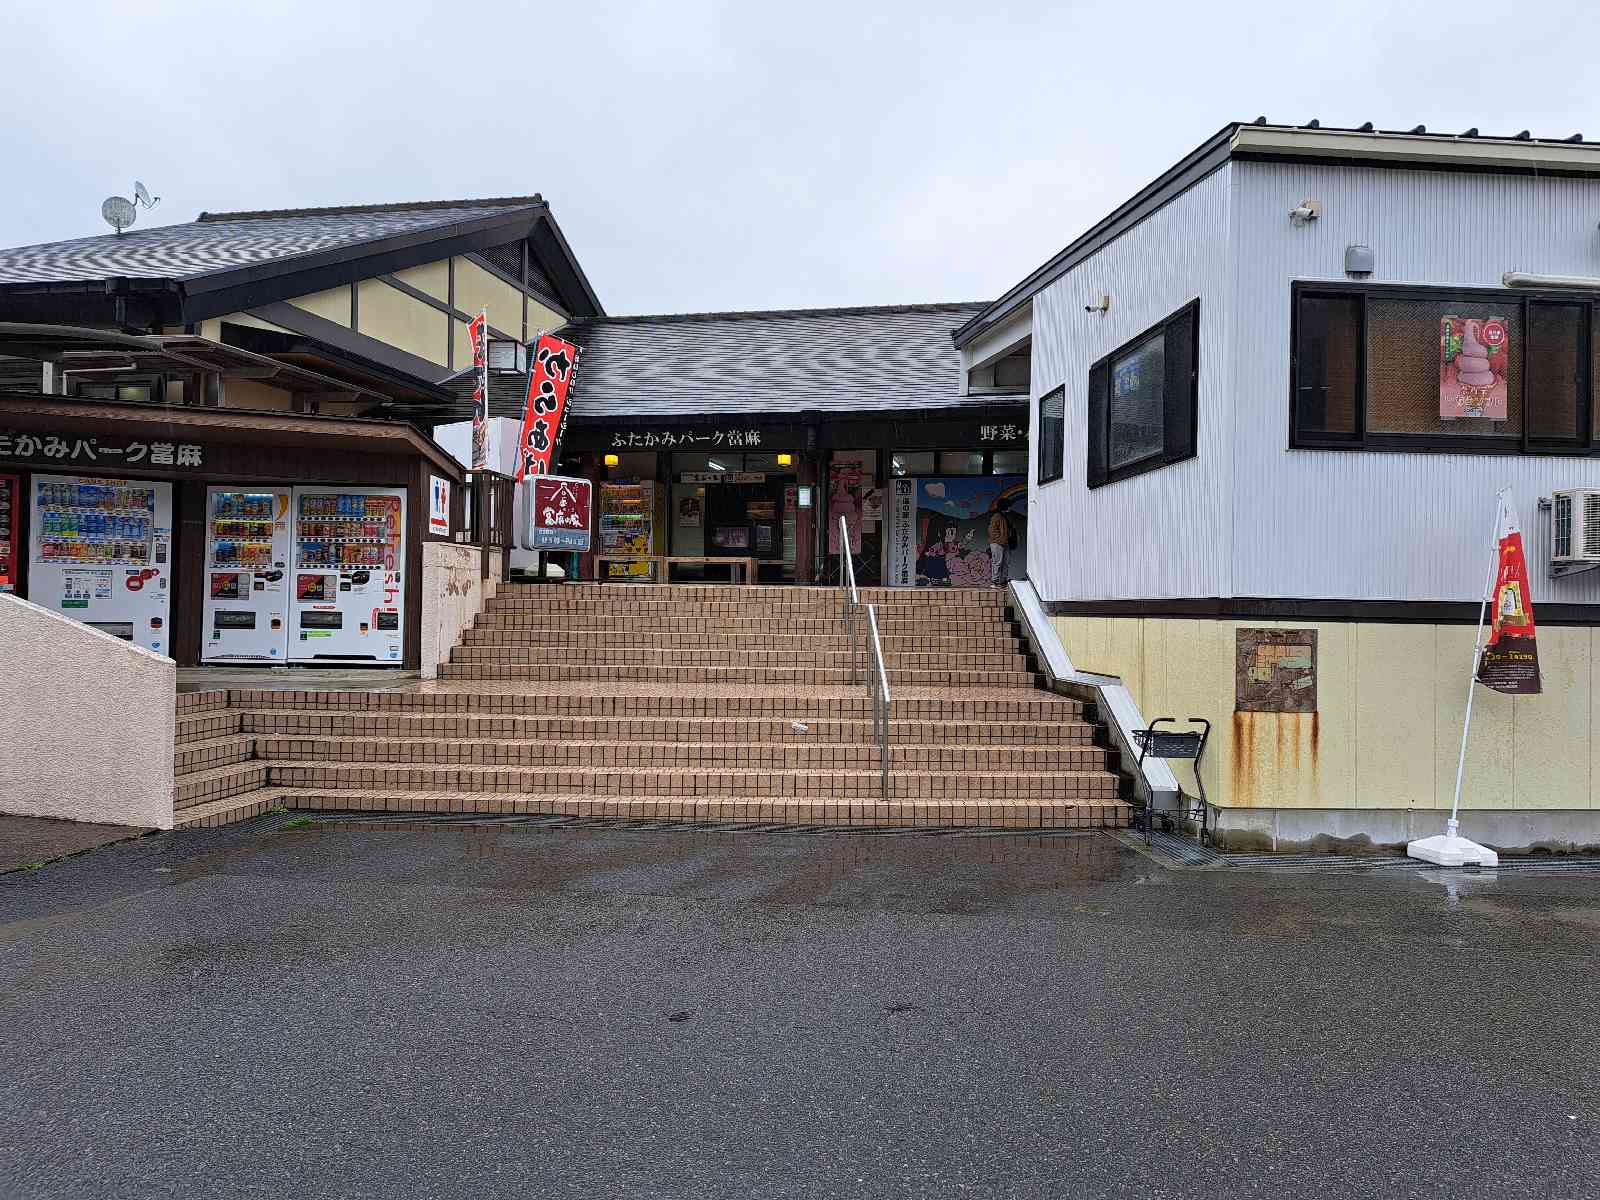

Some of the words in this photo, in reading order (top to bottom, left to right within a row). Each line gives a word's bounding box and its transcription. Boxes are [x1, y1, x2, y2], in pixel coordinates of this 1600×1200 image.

[611, 430, 761, 447] ふたかみパーク當麻
[980, 424, 1029, 440] 野菜・
